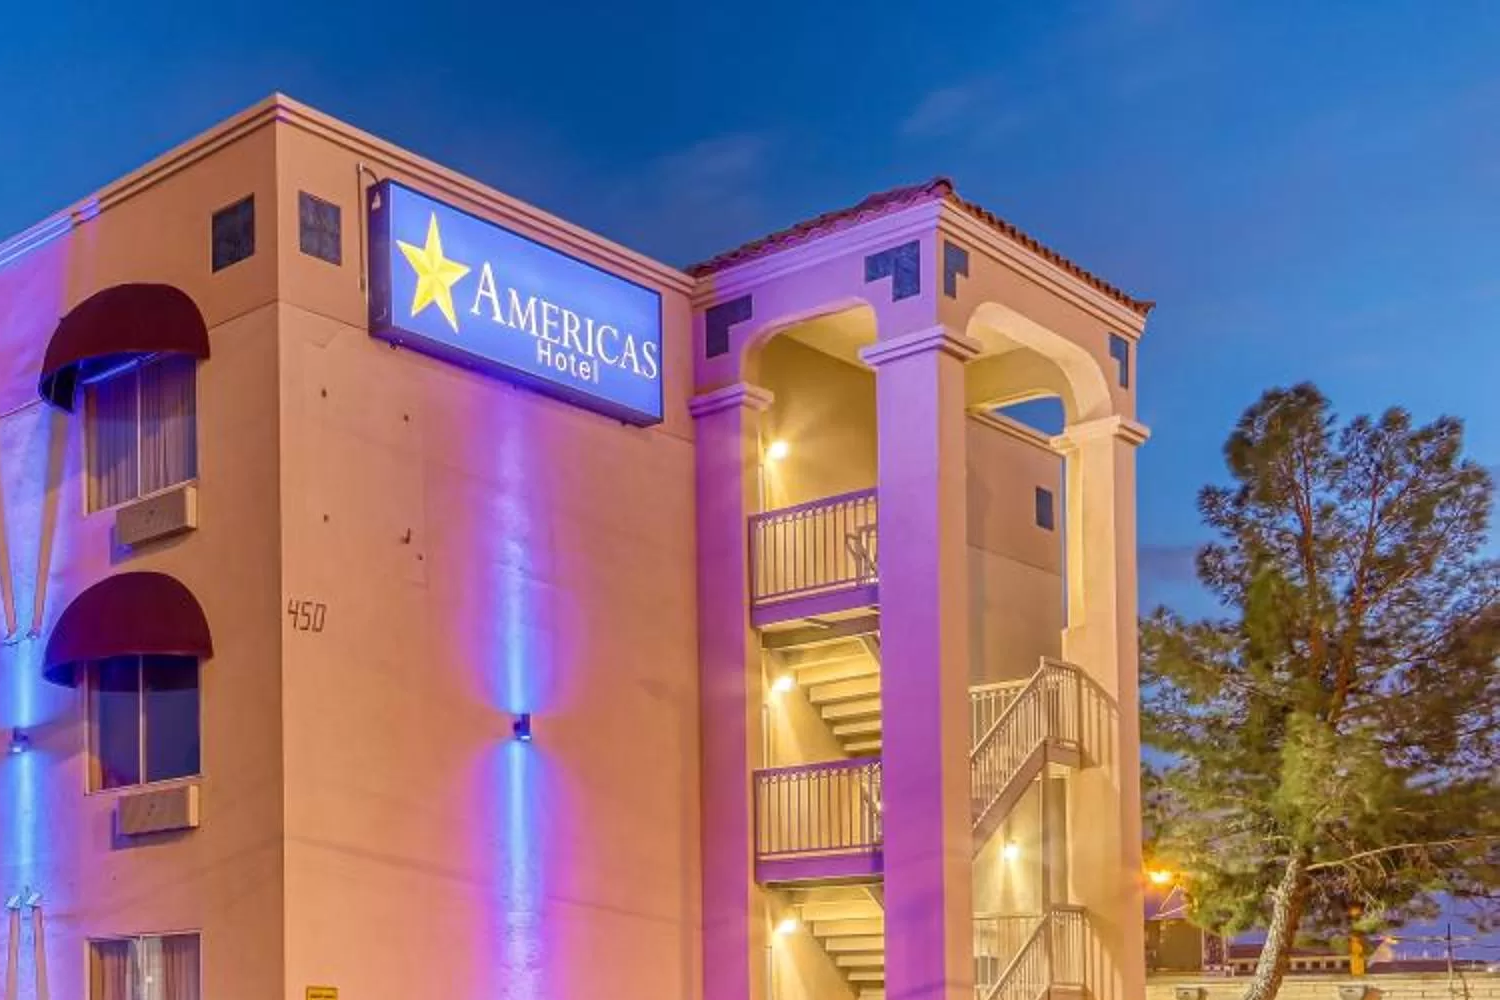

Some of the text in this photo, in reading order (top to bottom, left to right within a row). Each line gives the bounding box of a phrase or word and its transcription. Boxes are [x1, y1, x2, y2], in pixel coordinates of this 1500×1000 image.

[470, 260, 658, 379] AMERICAS
[537, 339, 599, 384] Hotel
[287, 599, 327, 632] 450
